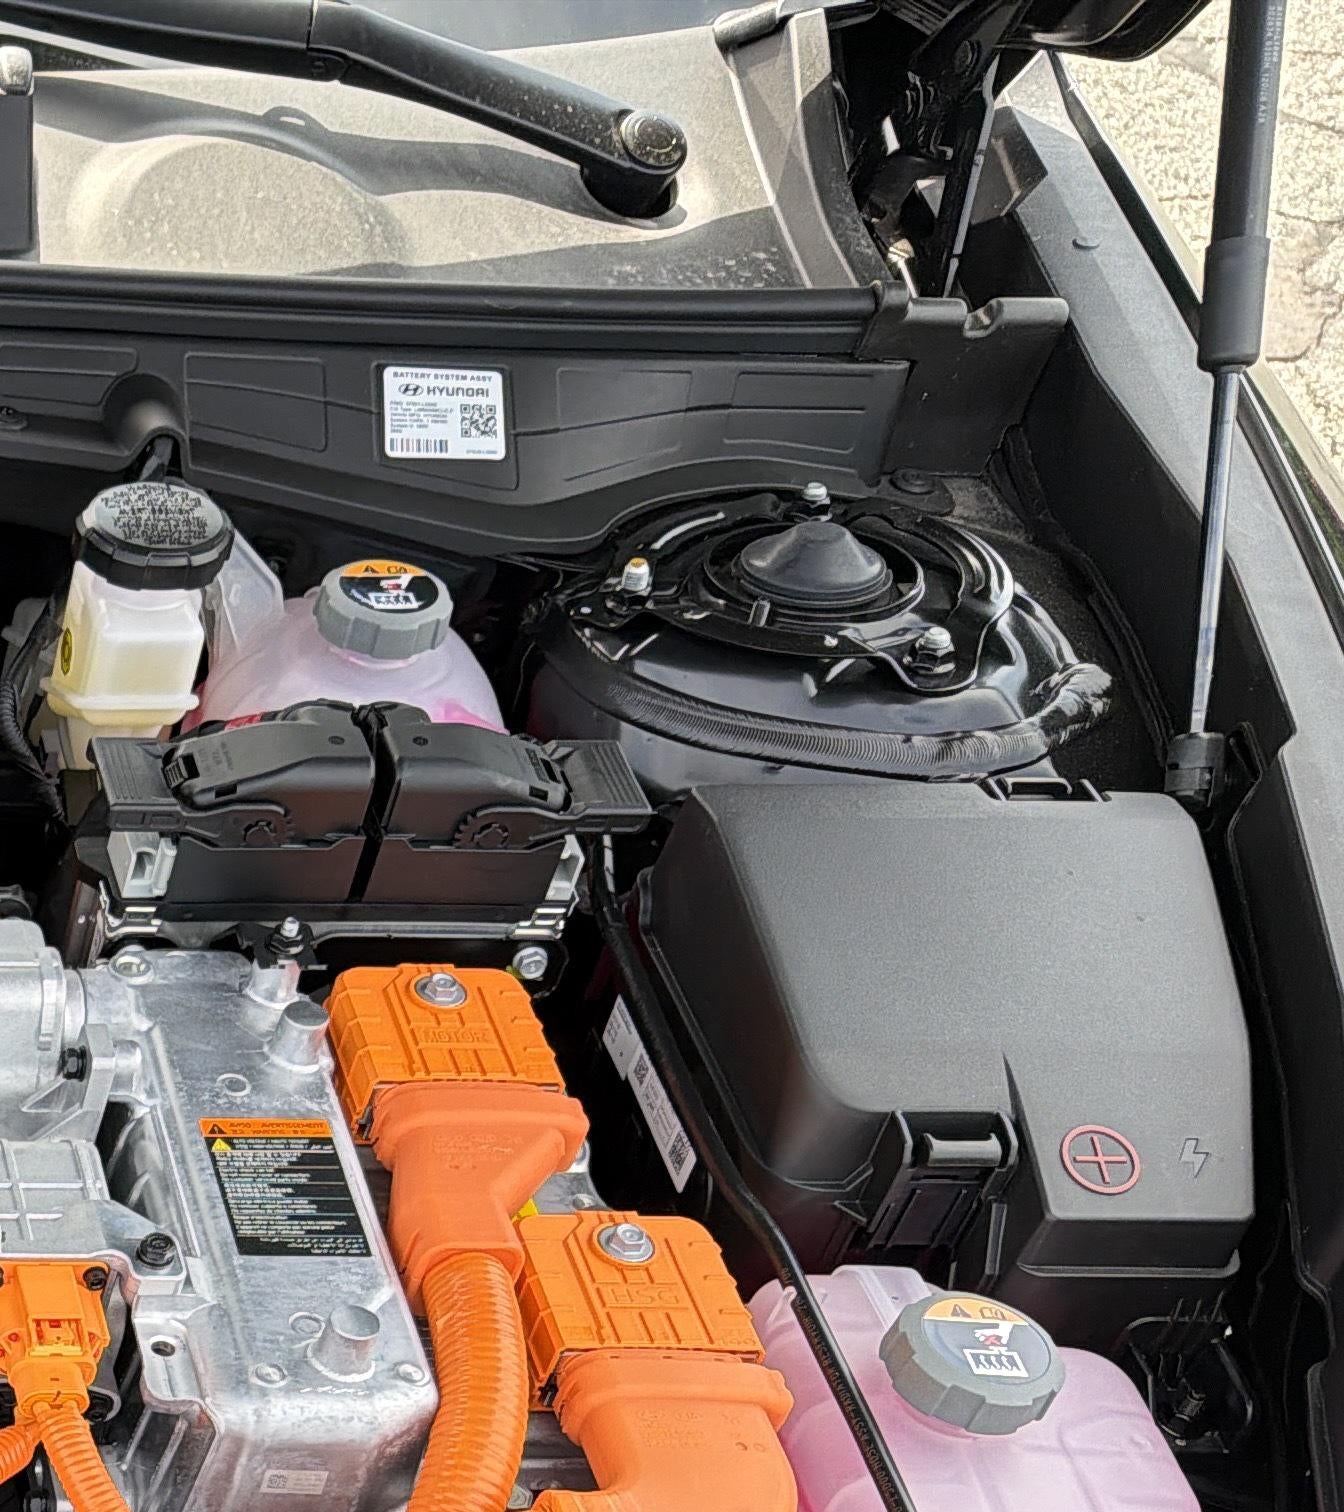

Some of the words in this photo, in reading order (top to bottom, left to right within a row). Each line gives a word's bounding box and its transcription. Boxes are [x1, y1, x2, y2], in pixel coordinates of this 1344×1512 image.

[392, 371, 431, 380] BATTERY
[433, 372, 468, 381] SYSTEM
[427, 386, 490, 398] HYUNDAI
[611, 1288, 681, 1305] HSG
